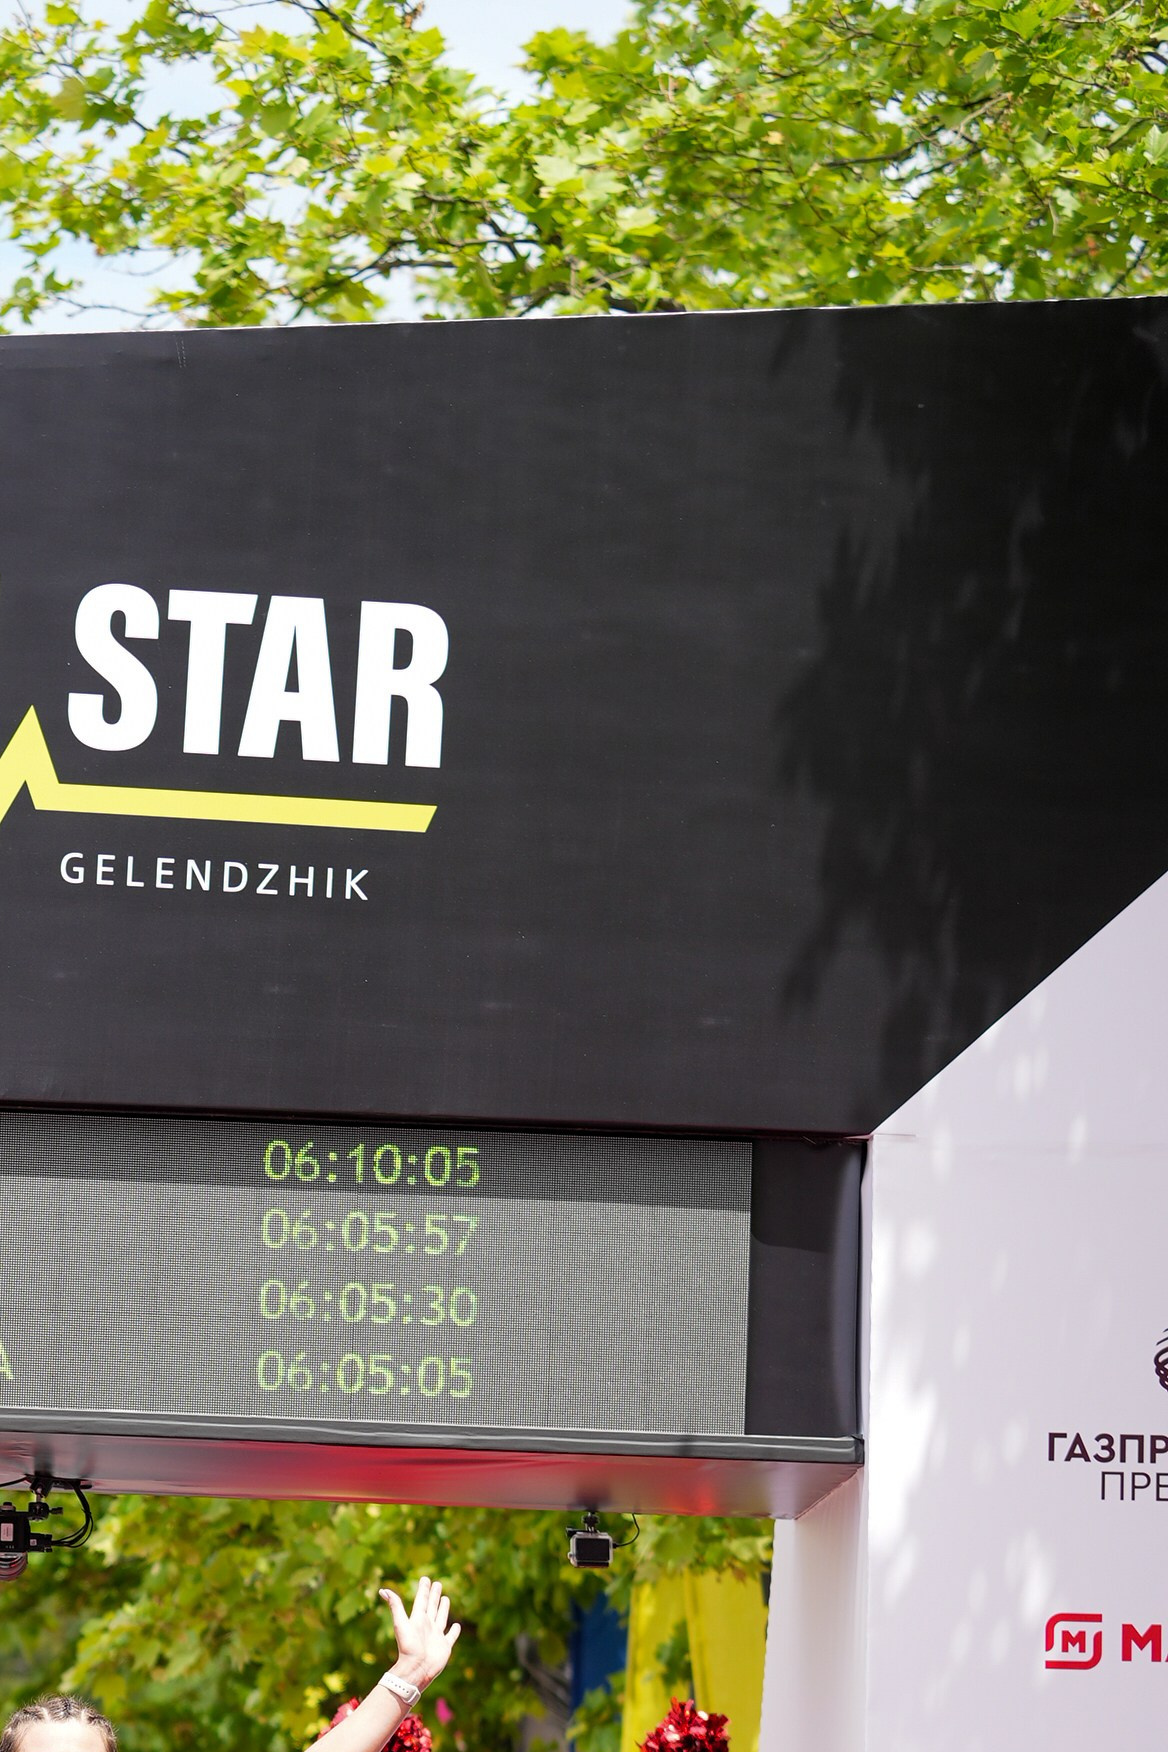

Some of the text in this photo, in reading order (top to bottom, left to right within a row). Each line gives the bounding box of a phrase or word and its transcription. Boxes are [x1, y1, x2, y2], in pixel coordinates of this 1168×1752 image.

[68, 583, 449, 768] STAR
[60, 852, 370, 902] GELENDZHIK
[263, 1140, 481, 1187] 06:10:05
[261, 1207, 479, 1255] 06:05:57
[259, 1279, 478, 1327] 06:05:30
[257, 1350, 475, 1398] 06:05:05
